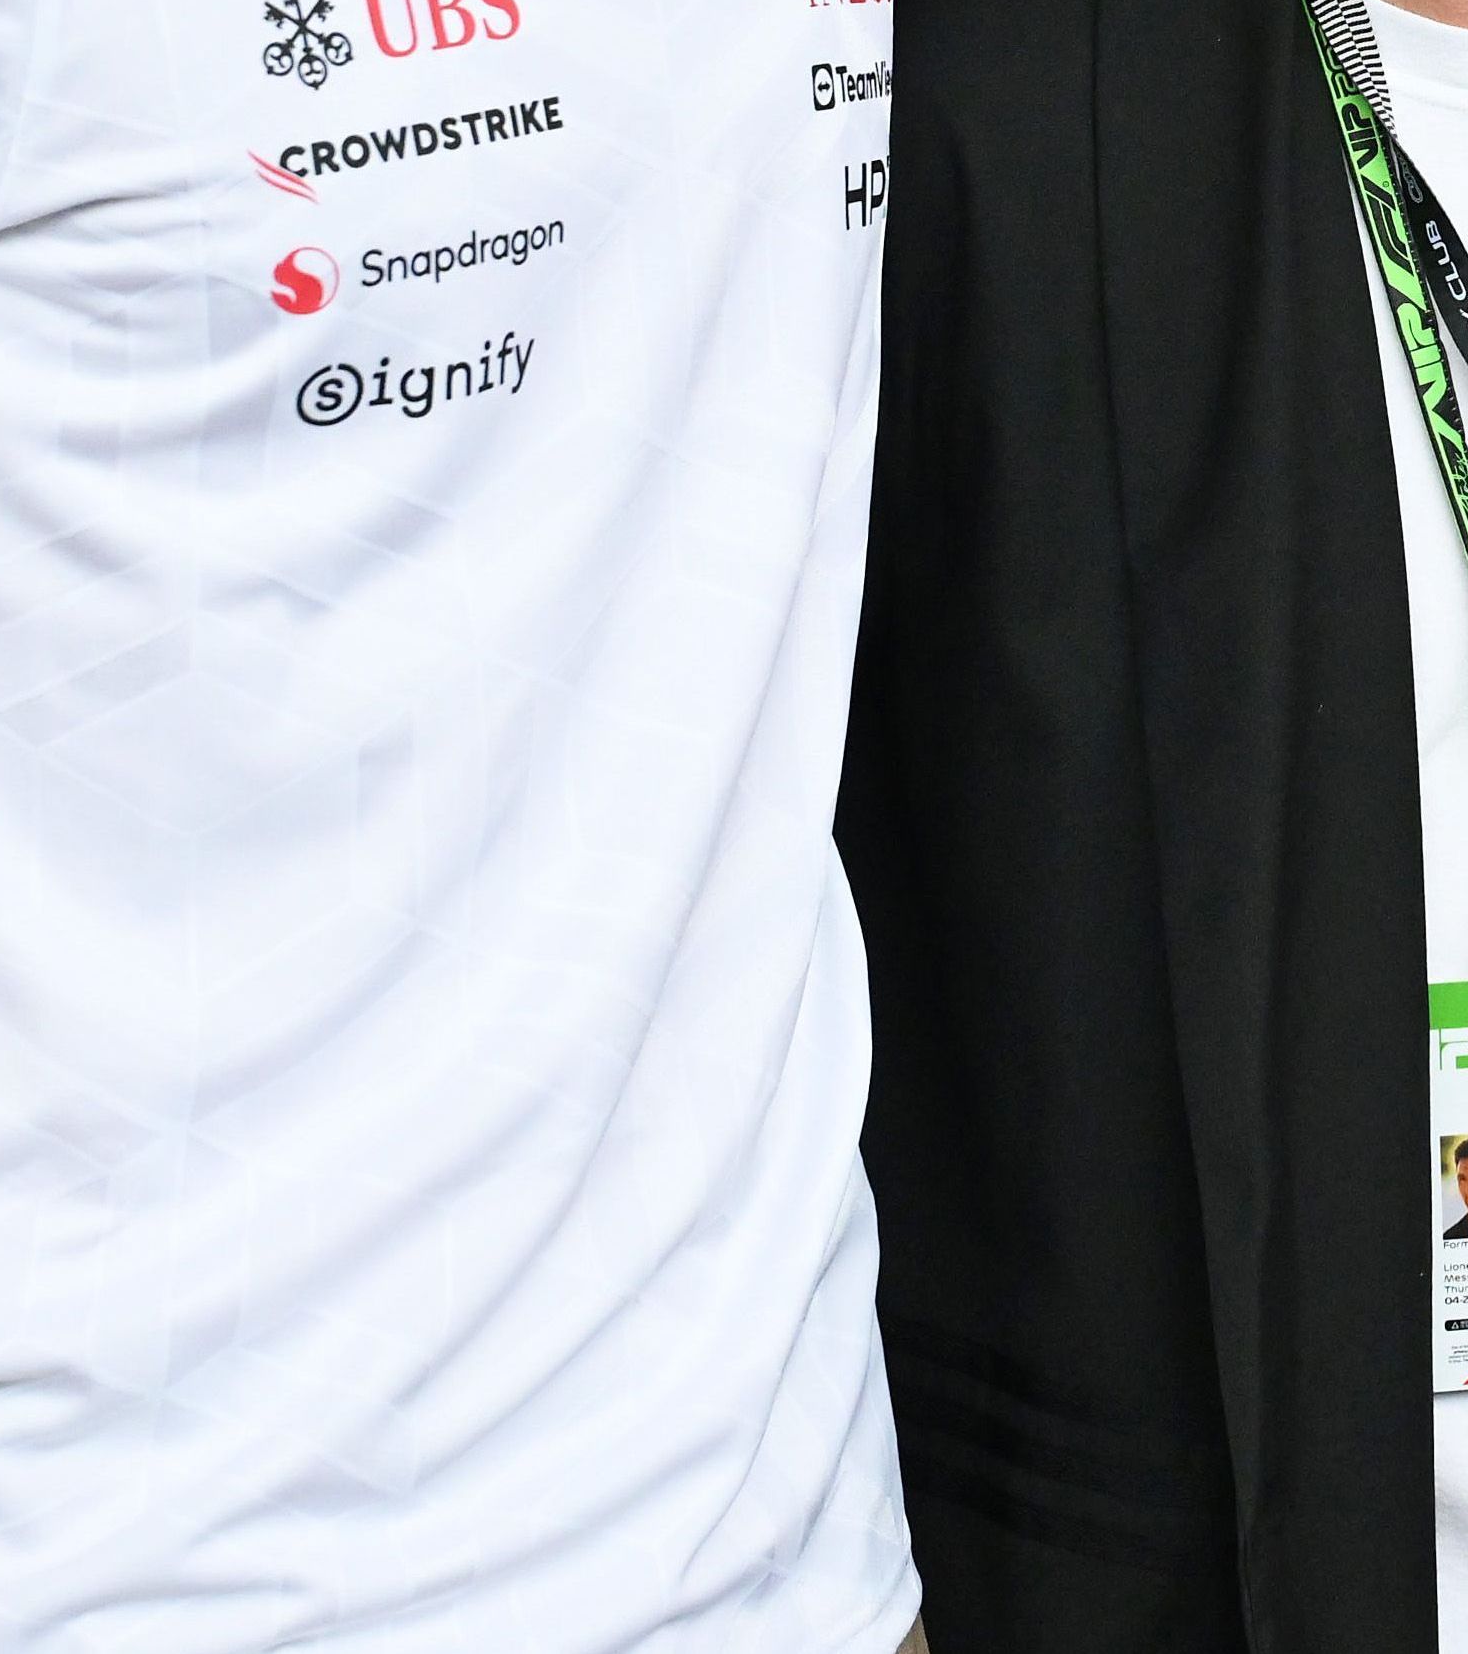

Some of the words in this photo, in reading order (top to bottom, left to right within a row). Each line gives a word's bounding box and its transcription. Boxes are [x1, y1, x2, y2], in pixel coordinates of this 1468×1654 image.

[278, 96, 565, 178] CROWDSTRIKE
[844, 156, 891, 231] HP
[361, 219, 565, 287] Snapdragon
[1425, 220, 1467, 300] CLUB
